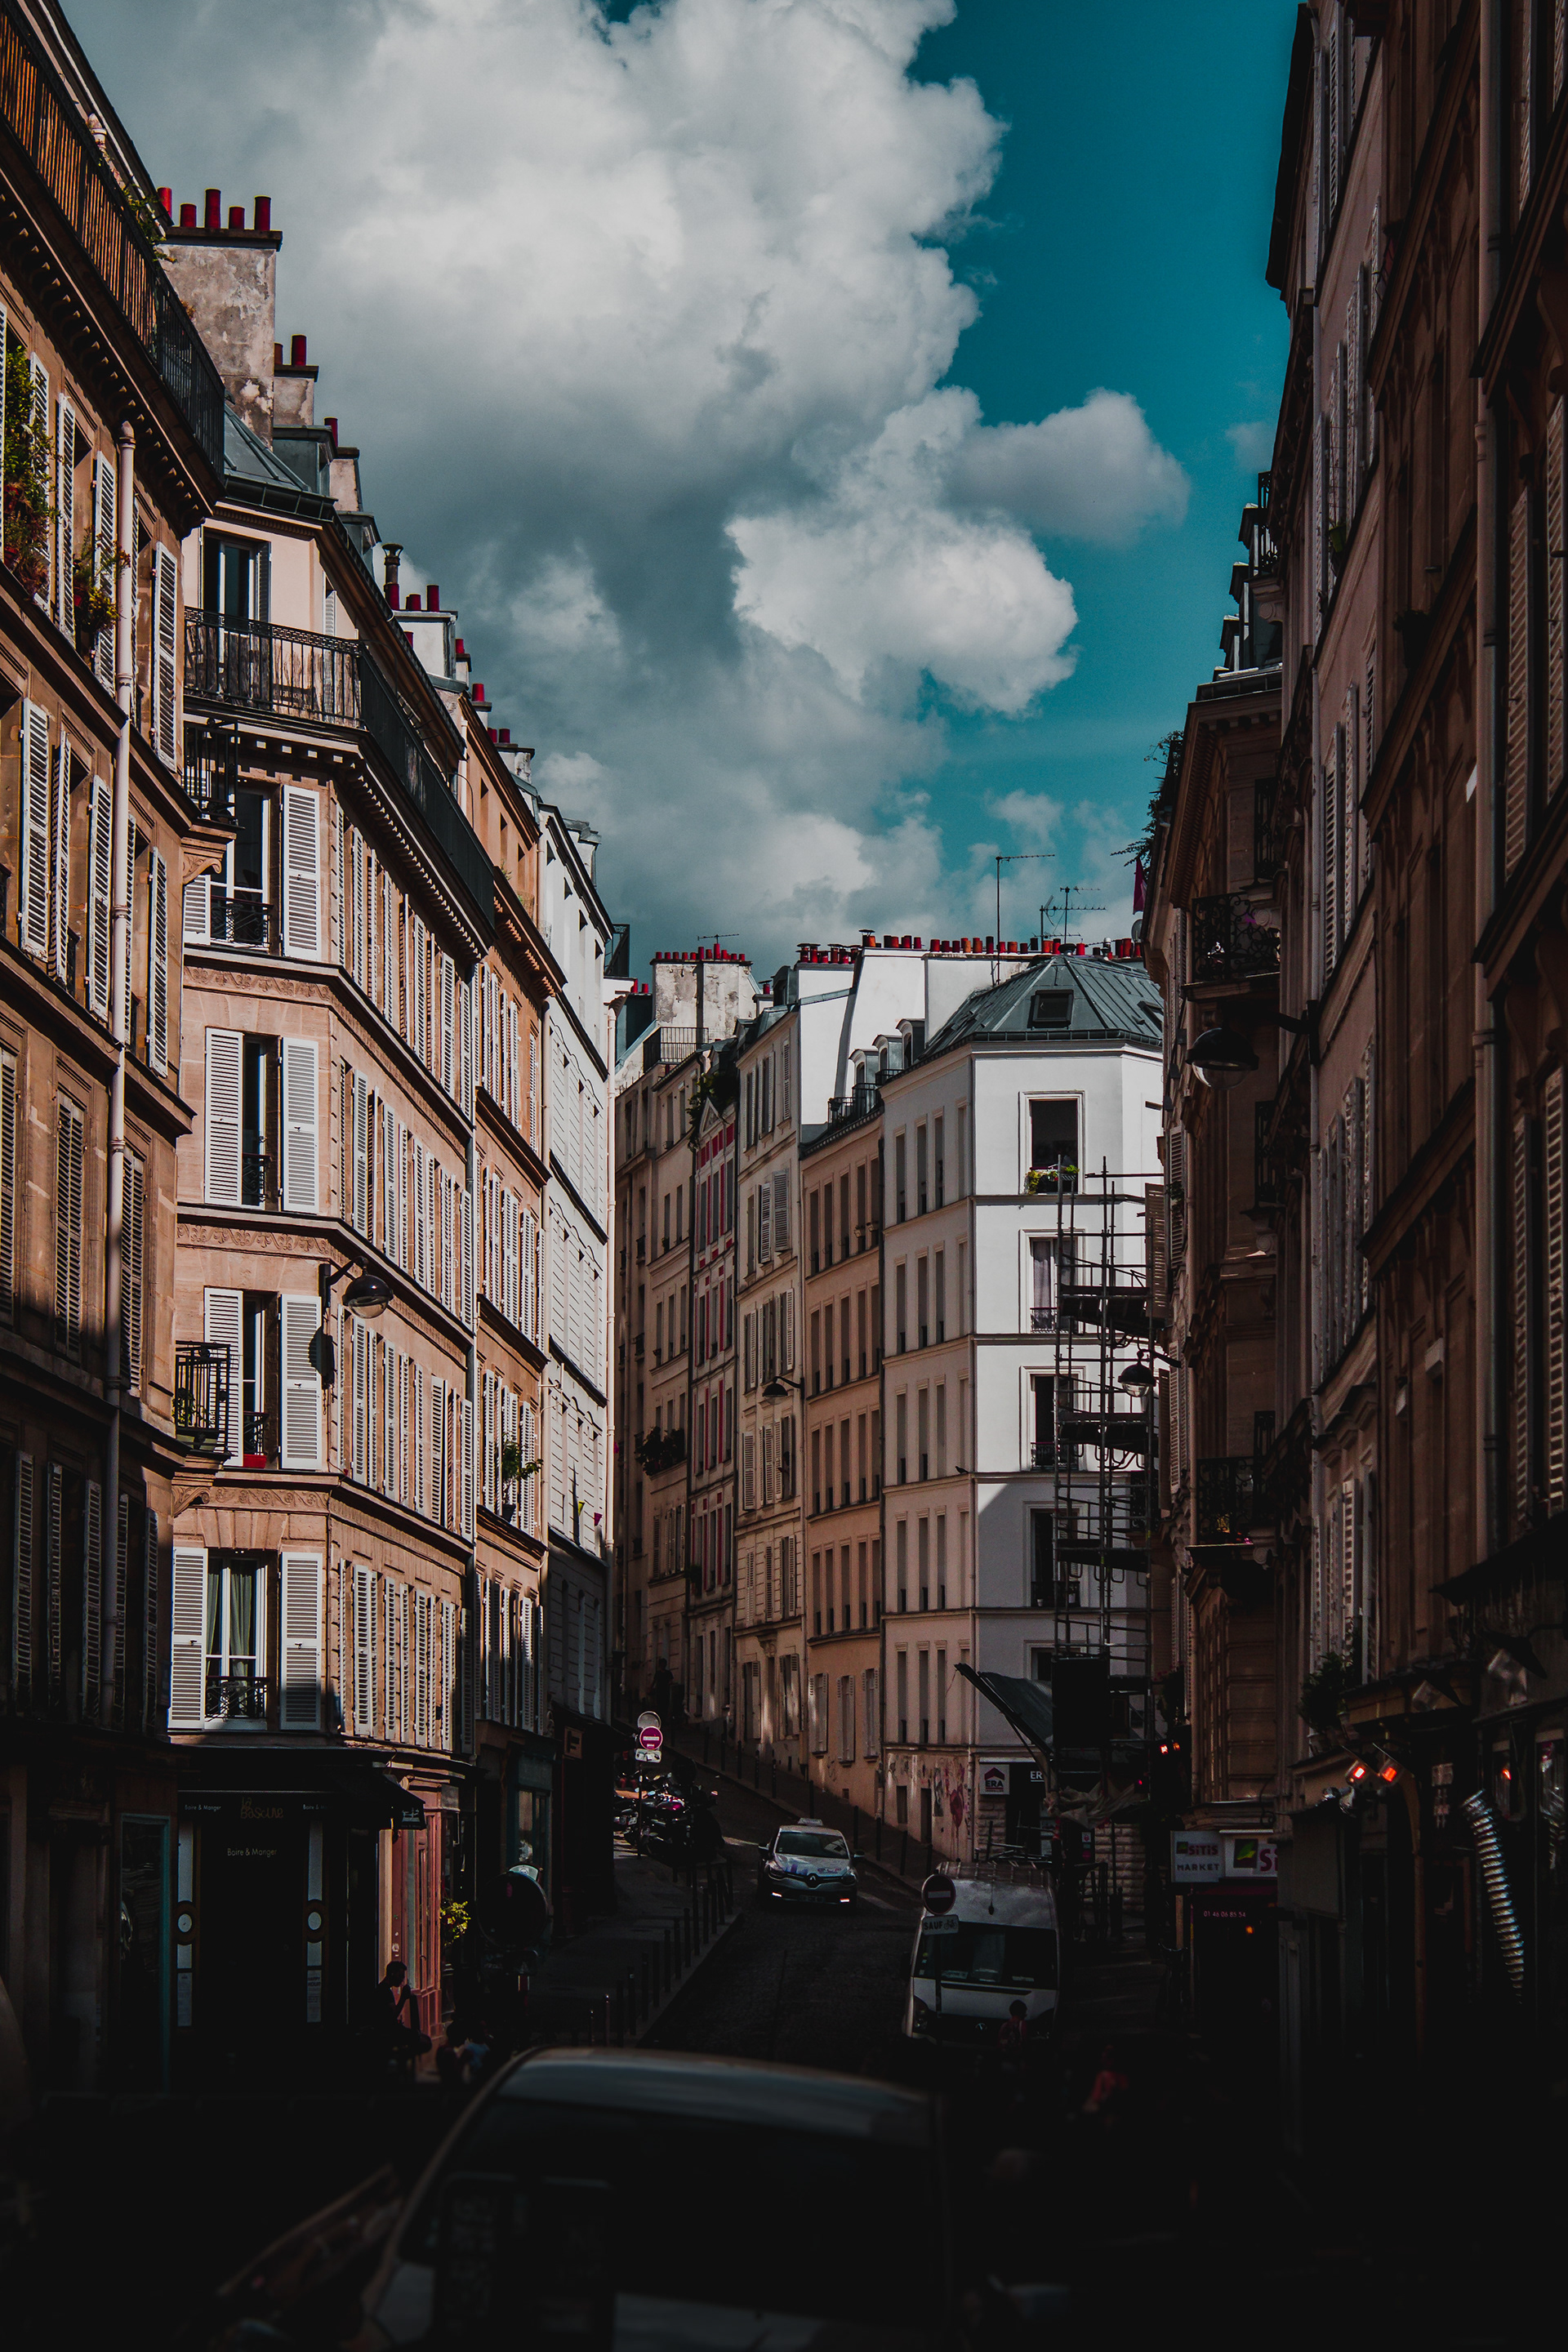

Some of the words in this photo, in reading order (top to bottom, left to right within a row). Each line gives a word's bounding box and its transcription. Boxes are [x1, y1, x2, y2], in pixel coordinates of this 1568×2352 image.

[1030, 1771, 1043, 1780] ER
[227, 1847, 244, 1856] Boire
[245, 1848, 250, 1856] &
[252, 1848, 278, 1858] Manger
[924, 1921, 943, 1931] SAUF
